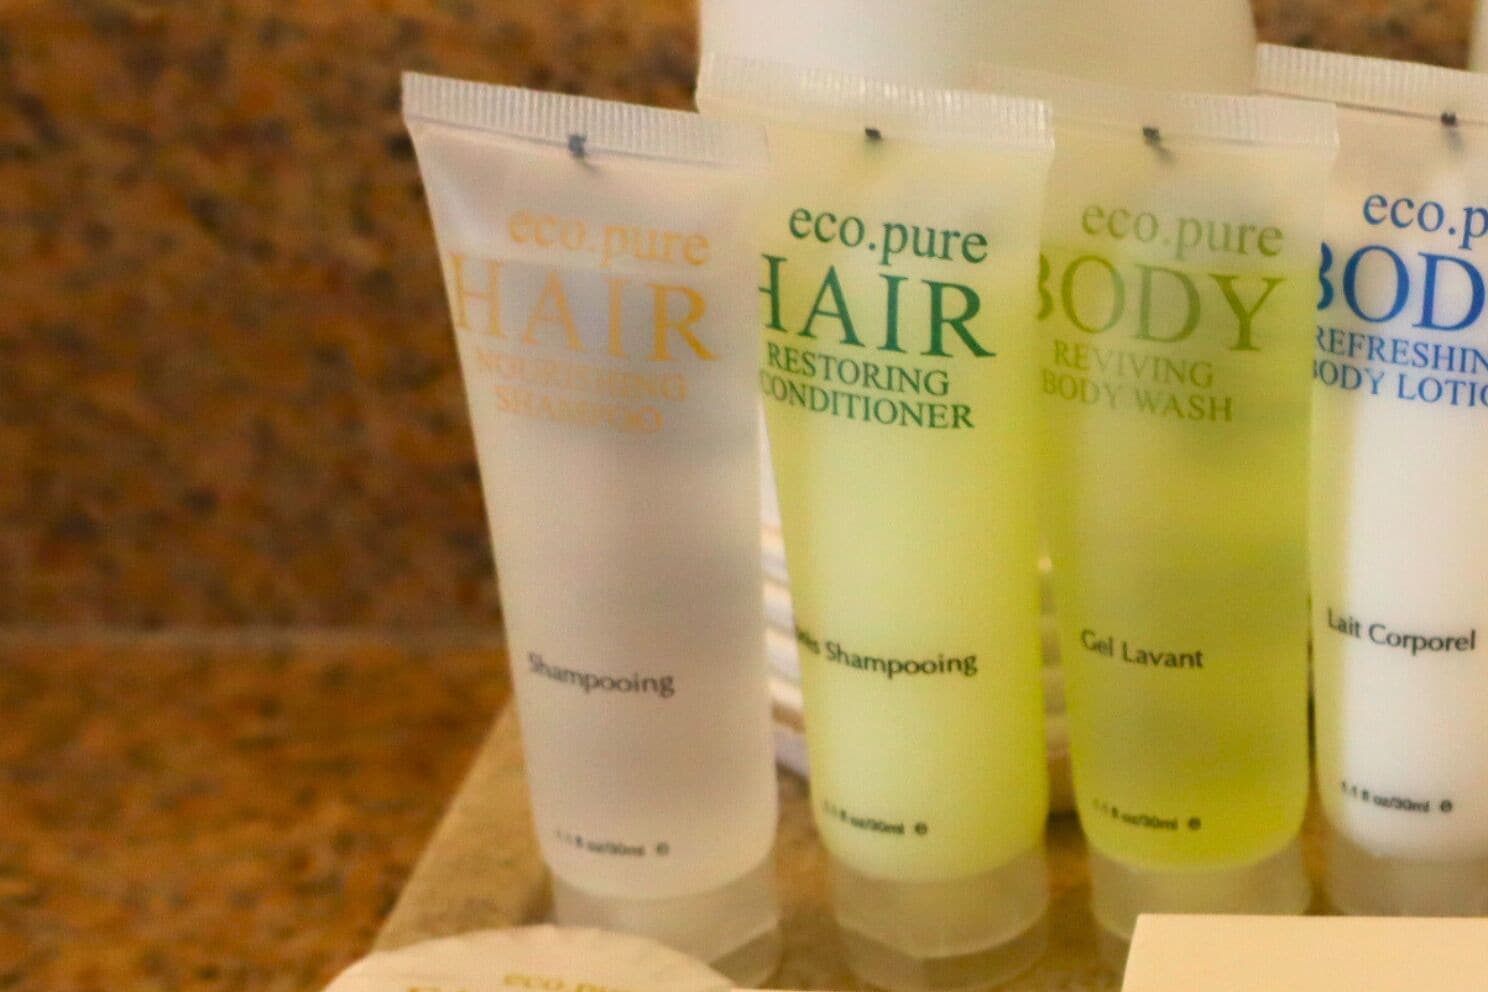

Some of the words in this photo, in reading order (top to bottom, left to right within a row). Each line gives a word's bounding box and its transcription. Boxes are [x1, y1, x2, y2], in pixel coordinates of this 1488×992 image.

[788, 206, 989, 266] eco.pure
[1081, 202, 1284, 263] eco.pure
[450, 253, 719, 362] HAIR
[767, 342, 950, 397] RESTORING
[1053, 340, 1214, 389] REVIVING
[1041, 367, 1122, 408] BODY
[1134, 388, 1233, 423] WASH
[1080, 628, 1114, 657] Gel
[1122, 641, 1203, 670] Lavant
[1327, 607, 1361, 640] Lait
[1368, 623, 1477, 656] Corporel
[528, 652, 675, 699] Shampooing
[824, 640, 978, 680] Shampooing
